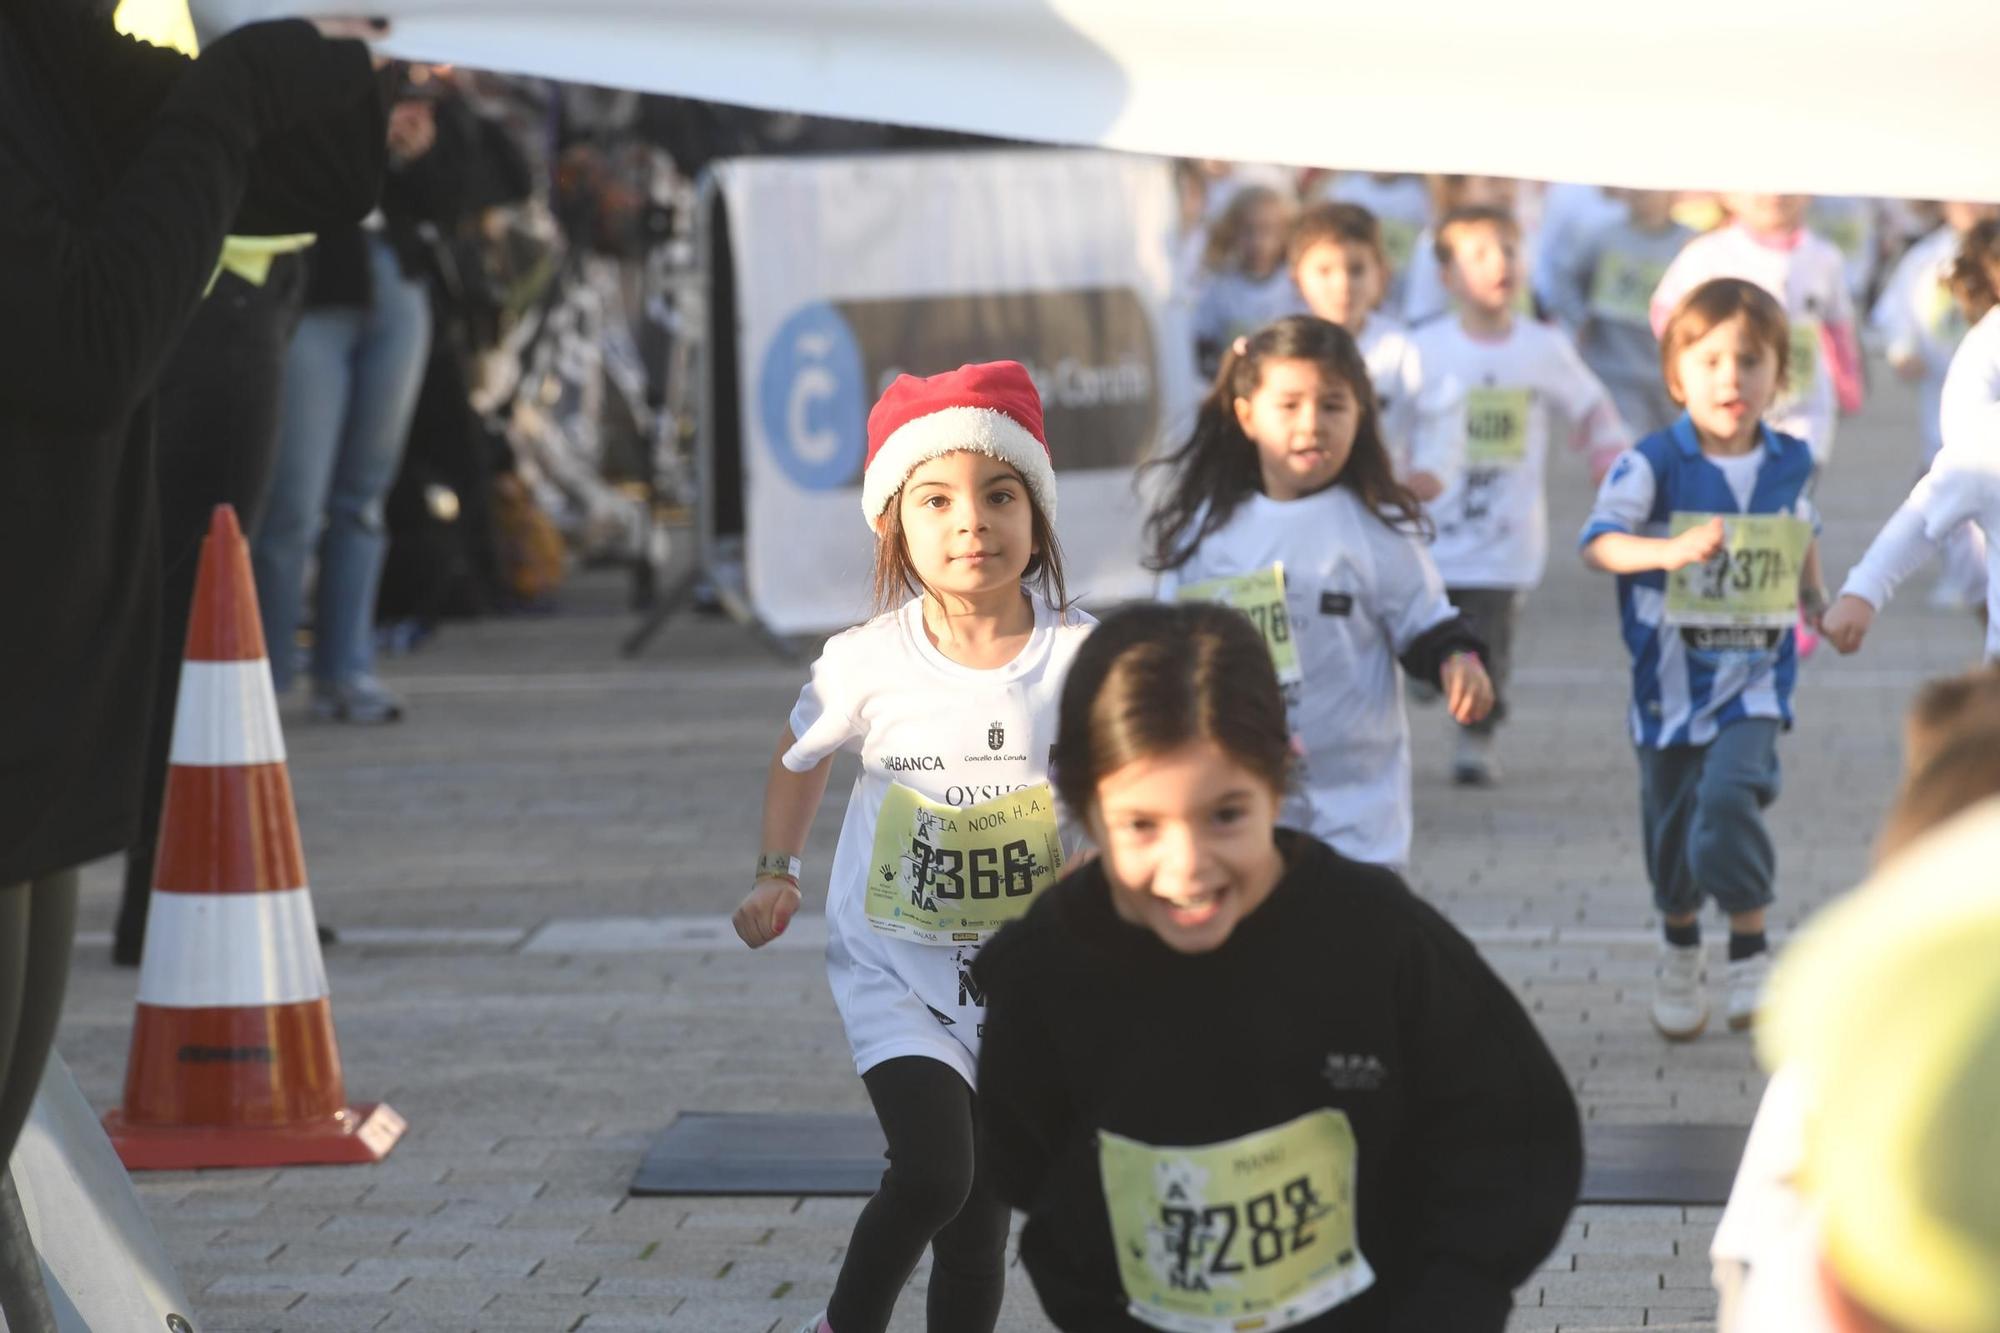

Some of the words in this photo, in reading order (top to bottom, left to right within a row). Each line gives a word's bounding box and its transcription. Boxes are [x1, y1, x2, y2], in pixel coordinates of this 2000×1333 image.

[888, 756, 945, 771] ABANCA
[964, 754, 992, 762] Concello
[945, 784, 1029, 806] OYS
[917, 806, 958, 833] SOFIA
[968, 811, 1007, 832] NOOR
[1013, 800, 1046, 820] H.A.
[912, 838, 1032, 899] 7366
